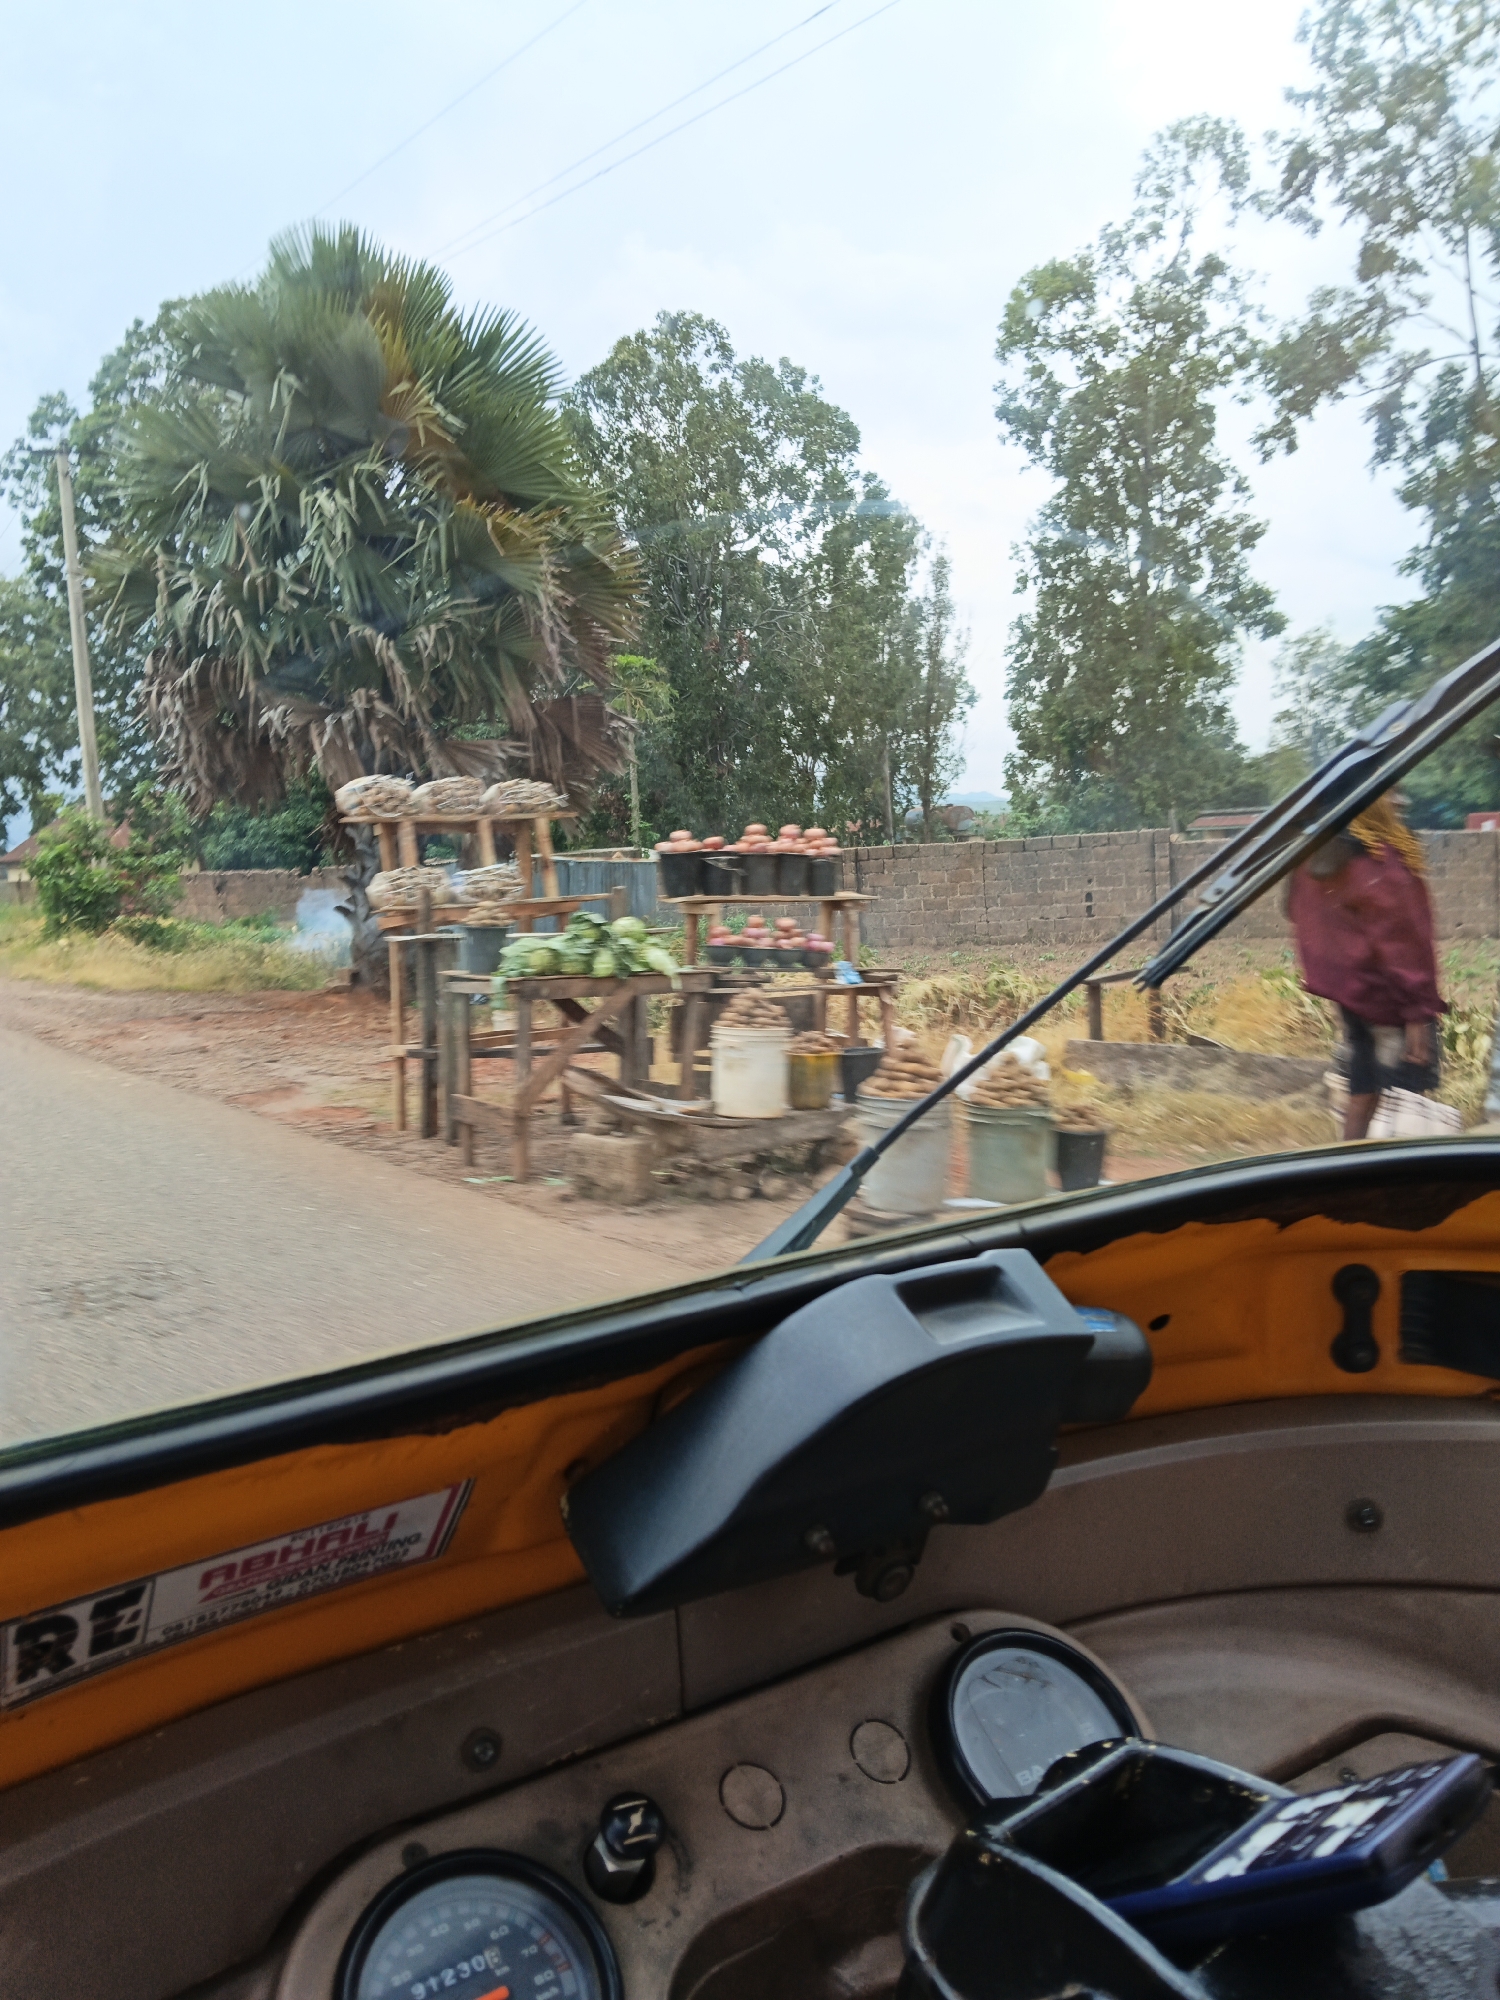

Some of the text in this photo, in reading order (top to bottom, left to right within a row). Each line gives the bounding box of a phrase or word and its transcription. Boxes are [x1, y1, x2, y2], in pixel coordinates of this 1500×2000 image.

[199, 1512, 399, 1591] ABHALI
[335, 1532, 422, 1569] PRINTING
[490, 1925, 509, 1940] 60
[521, 1945, 538, 1957] 70
[534, 1969, 555, 1986] 80
